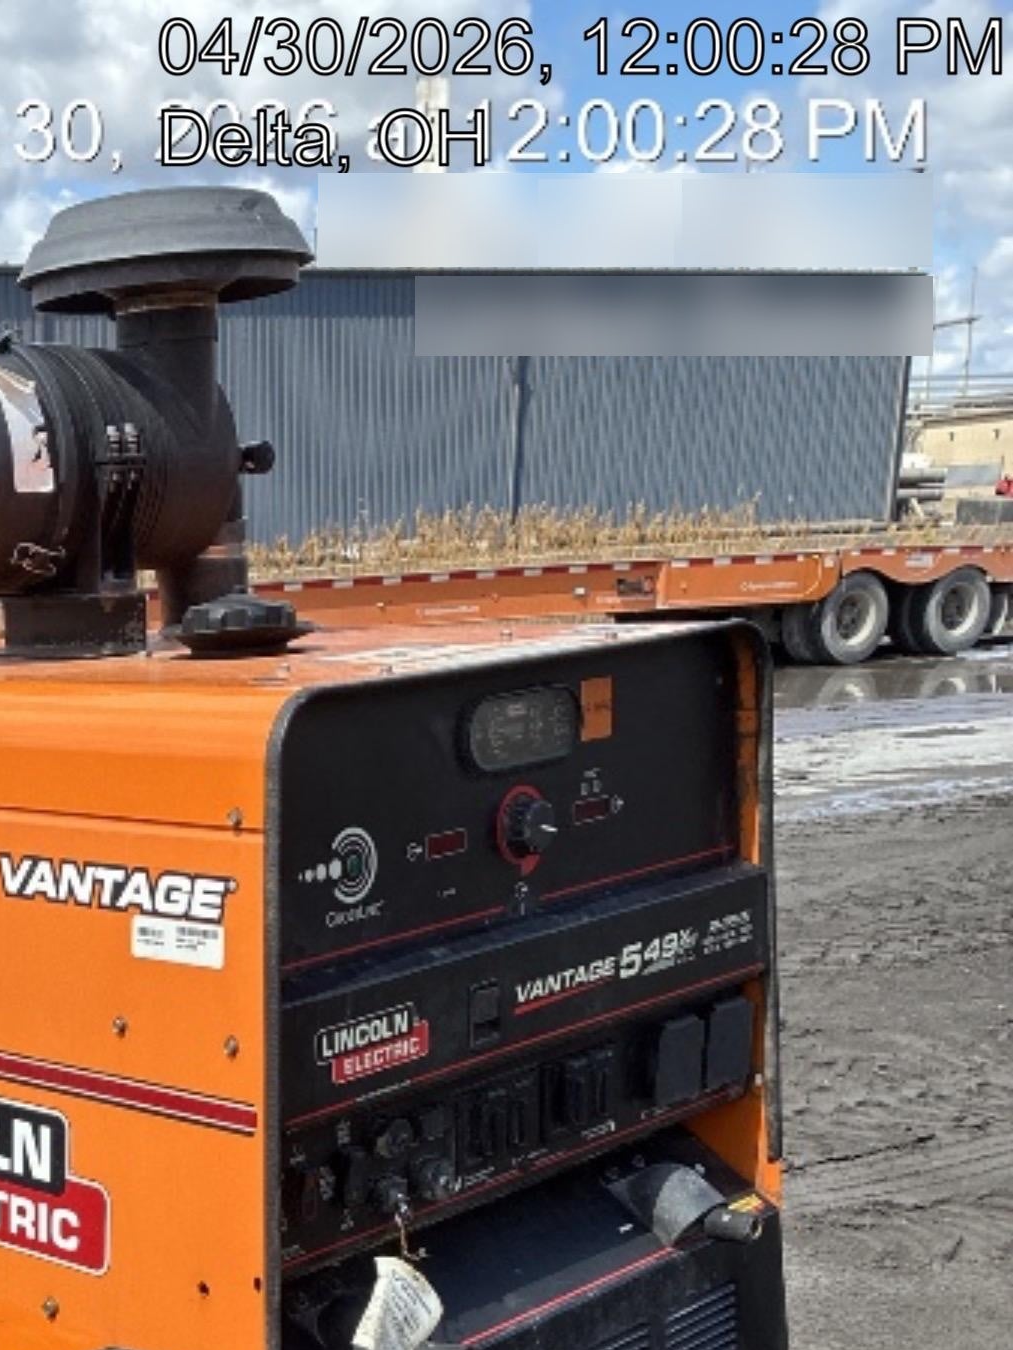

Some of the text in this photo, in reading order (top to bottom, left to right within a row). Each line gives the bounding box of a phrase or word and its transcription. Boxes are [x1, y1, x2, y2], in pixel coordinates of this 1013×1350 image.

[516, 956, 615, 1003] VANTAGE
[322, 1010, 408, 1057] LINCOLN
[344, 1037, 420, 1076] ELECTRIC
